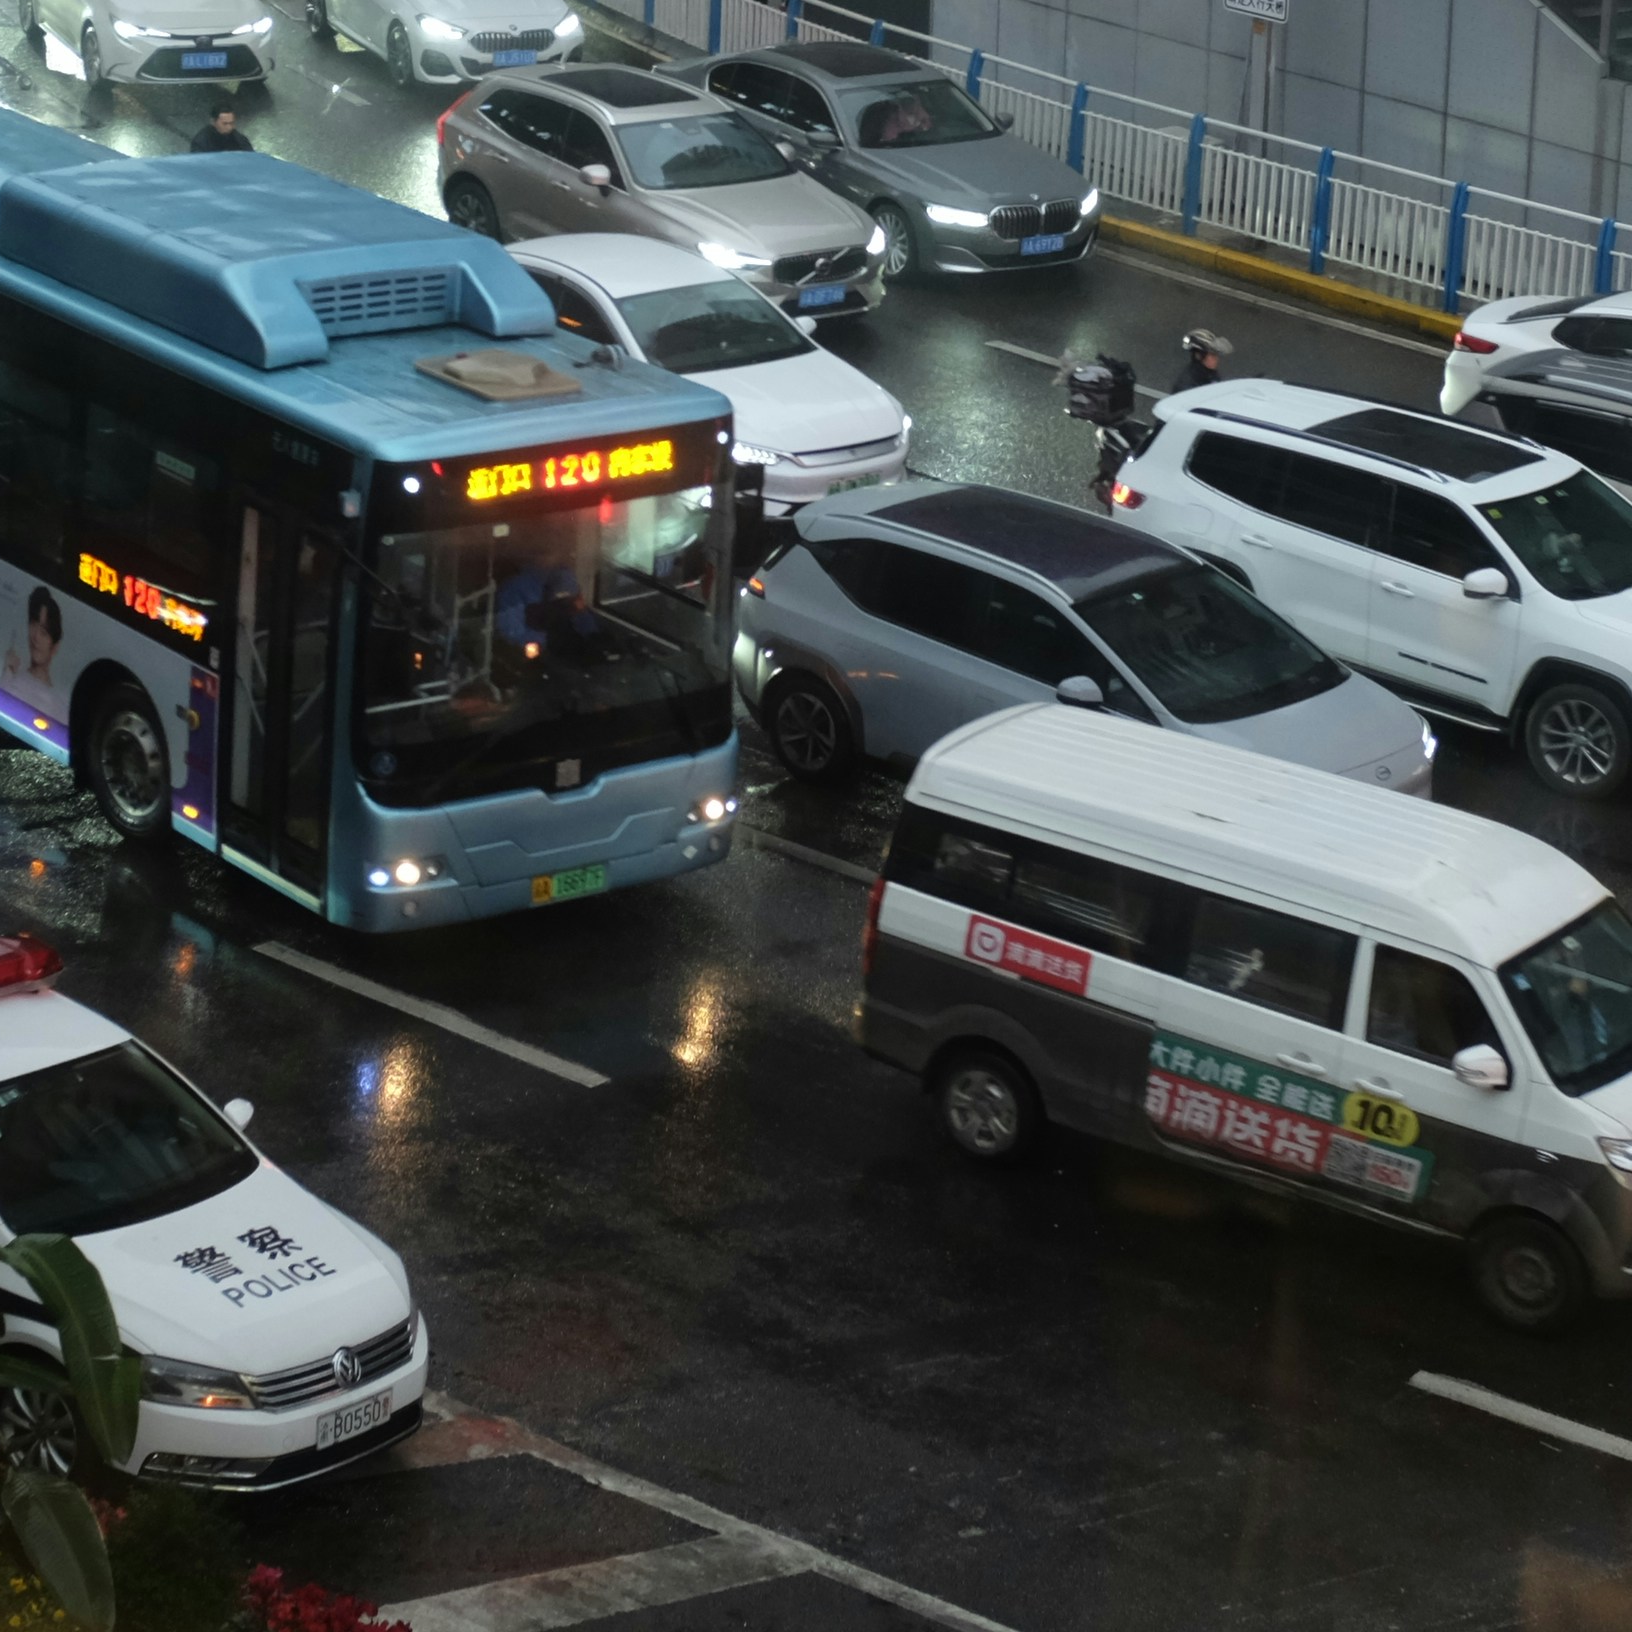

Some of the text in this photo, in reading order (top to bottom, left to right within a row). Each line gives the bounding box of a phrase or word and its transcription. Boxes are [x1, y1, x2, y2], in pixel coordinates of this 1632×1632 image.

[545, 450, 601, 489] 120
[123, 575, 162, 620] 120
[1149, 1041, 1336, 1120] 大件小件 全能送
[173, 1225, 303, 1284] 警察
[221, 1256, 337, 1308] POLICE
